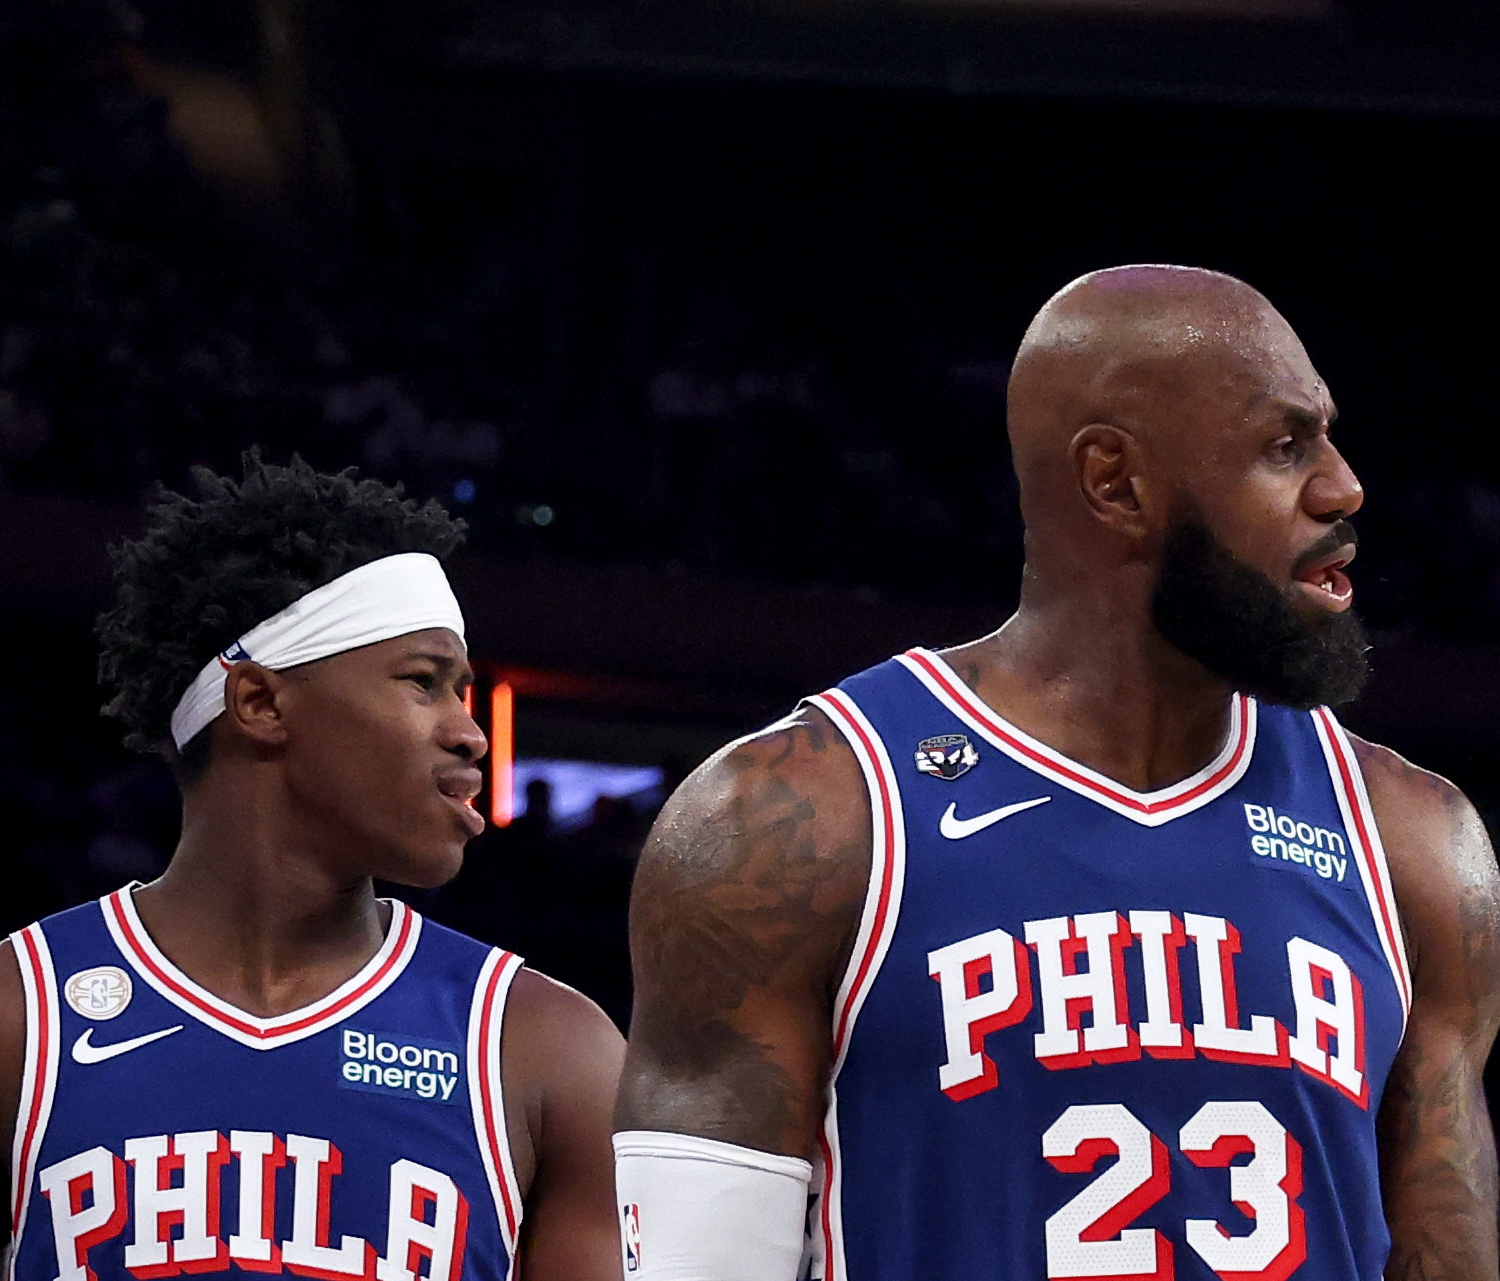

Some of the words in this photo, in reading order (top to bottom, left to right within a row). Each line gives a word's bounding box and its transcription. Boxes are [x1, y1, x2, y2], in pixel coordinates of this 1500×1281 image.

[1243, 803, 1347, 856] Bloom
[1250, 831, 1348, 883] energy
[927, 910, 1369, 1111] PHILA
[342, 1030, 458, 1074] Bloom
[342, 1061, 458, 1101] energy
